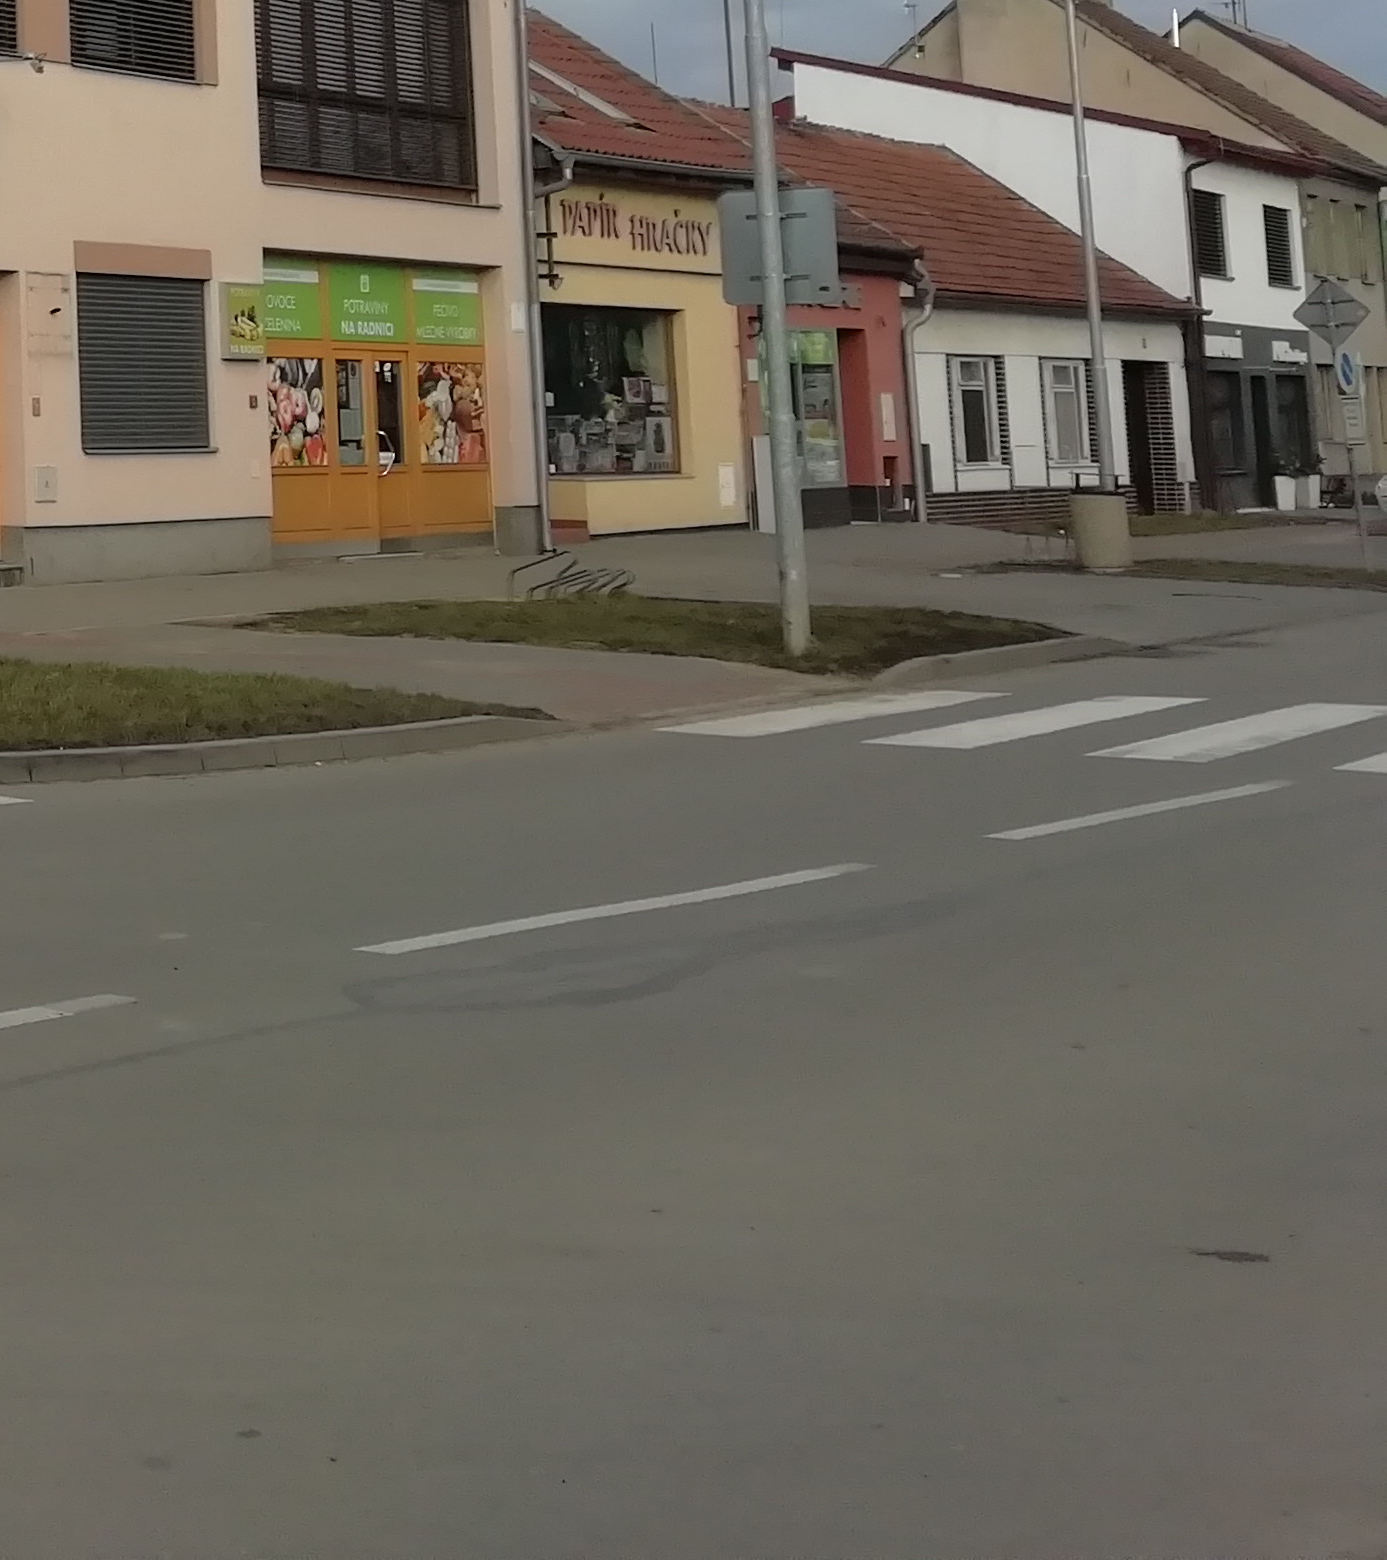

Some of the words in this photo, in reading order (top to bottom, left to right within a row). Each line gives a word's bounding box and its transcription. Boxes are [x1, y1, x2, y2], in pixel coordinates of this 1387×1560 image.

[559, 192, 620, 240] PAPÍR
[628, 208, 713, 257] HRAČKY
[267, 294, 296, 309] OVOCE
[343, 299, 389, 315] POTRAVINY
[341, 320, 355, 335] NA
[357, 321, 394, 337] RADNICI
